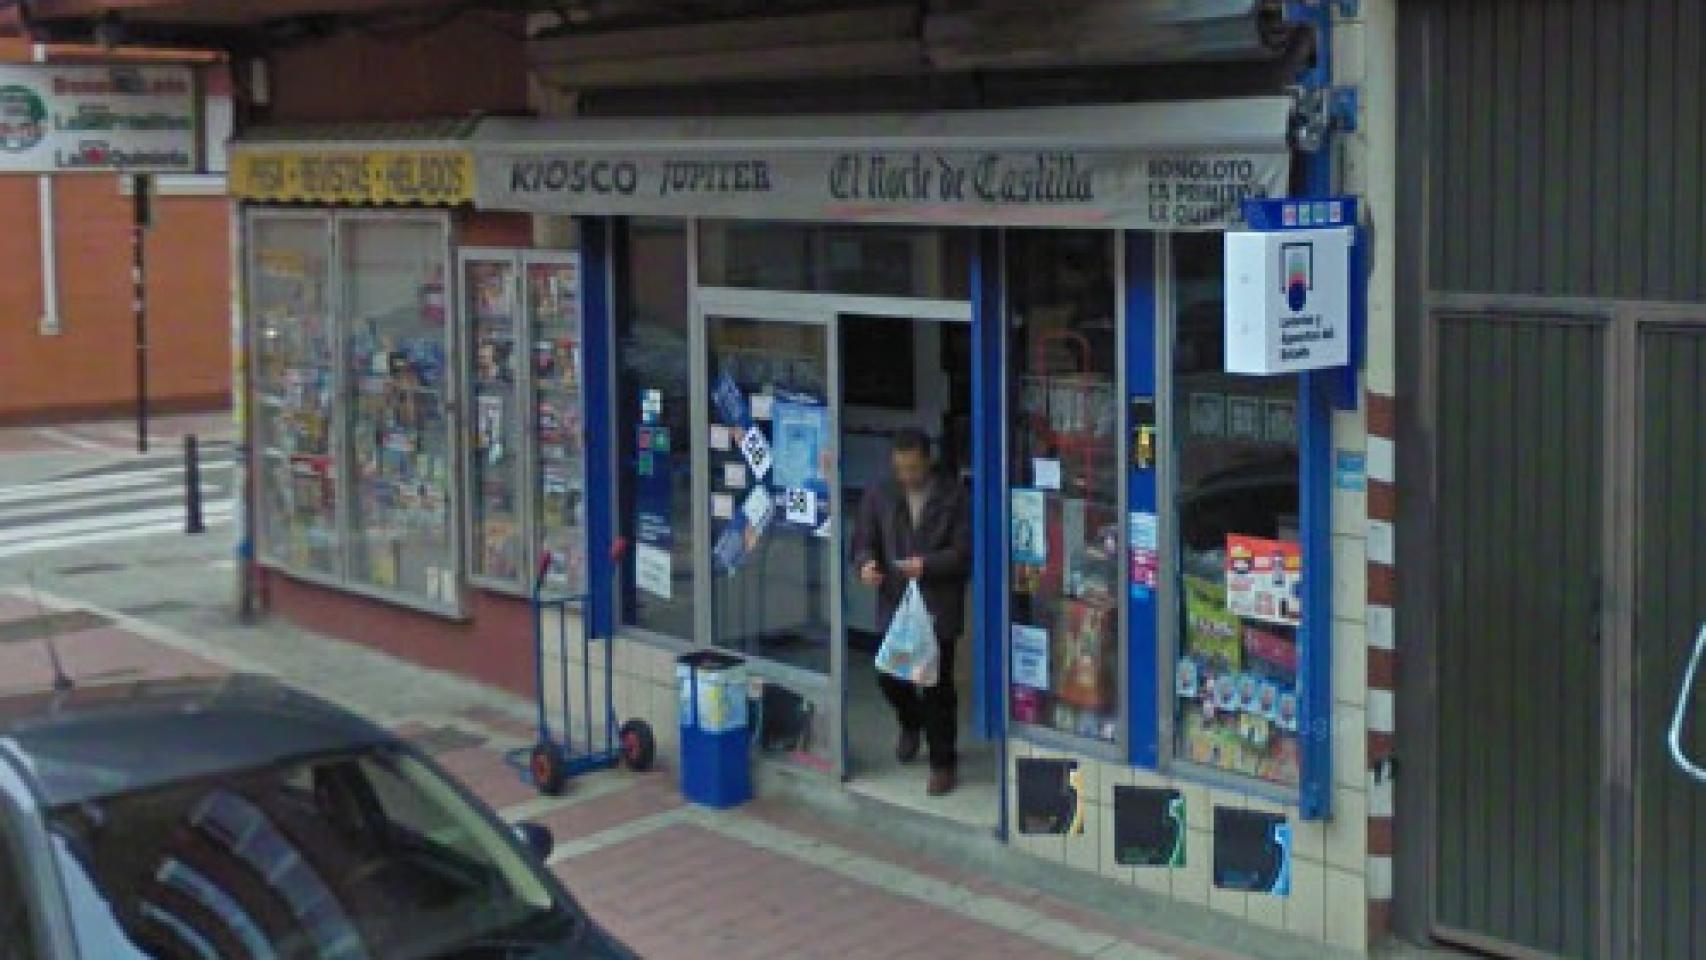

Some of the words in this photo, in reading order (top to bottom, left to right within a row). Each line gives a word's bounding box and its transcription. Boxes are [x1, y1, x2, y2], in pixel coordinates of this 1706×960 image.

[510, 159, 637, 195] KIOSCO
[659, 158, 772, 196] JUPITER
[830, 153, 861, 199] El
[974, 153, 1094, 202] Castilla
